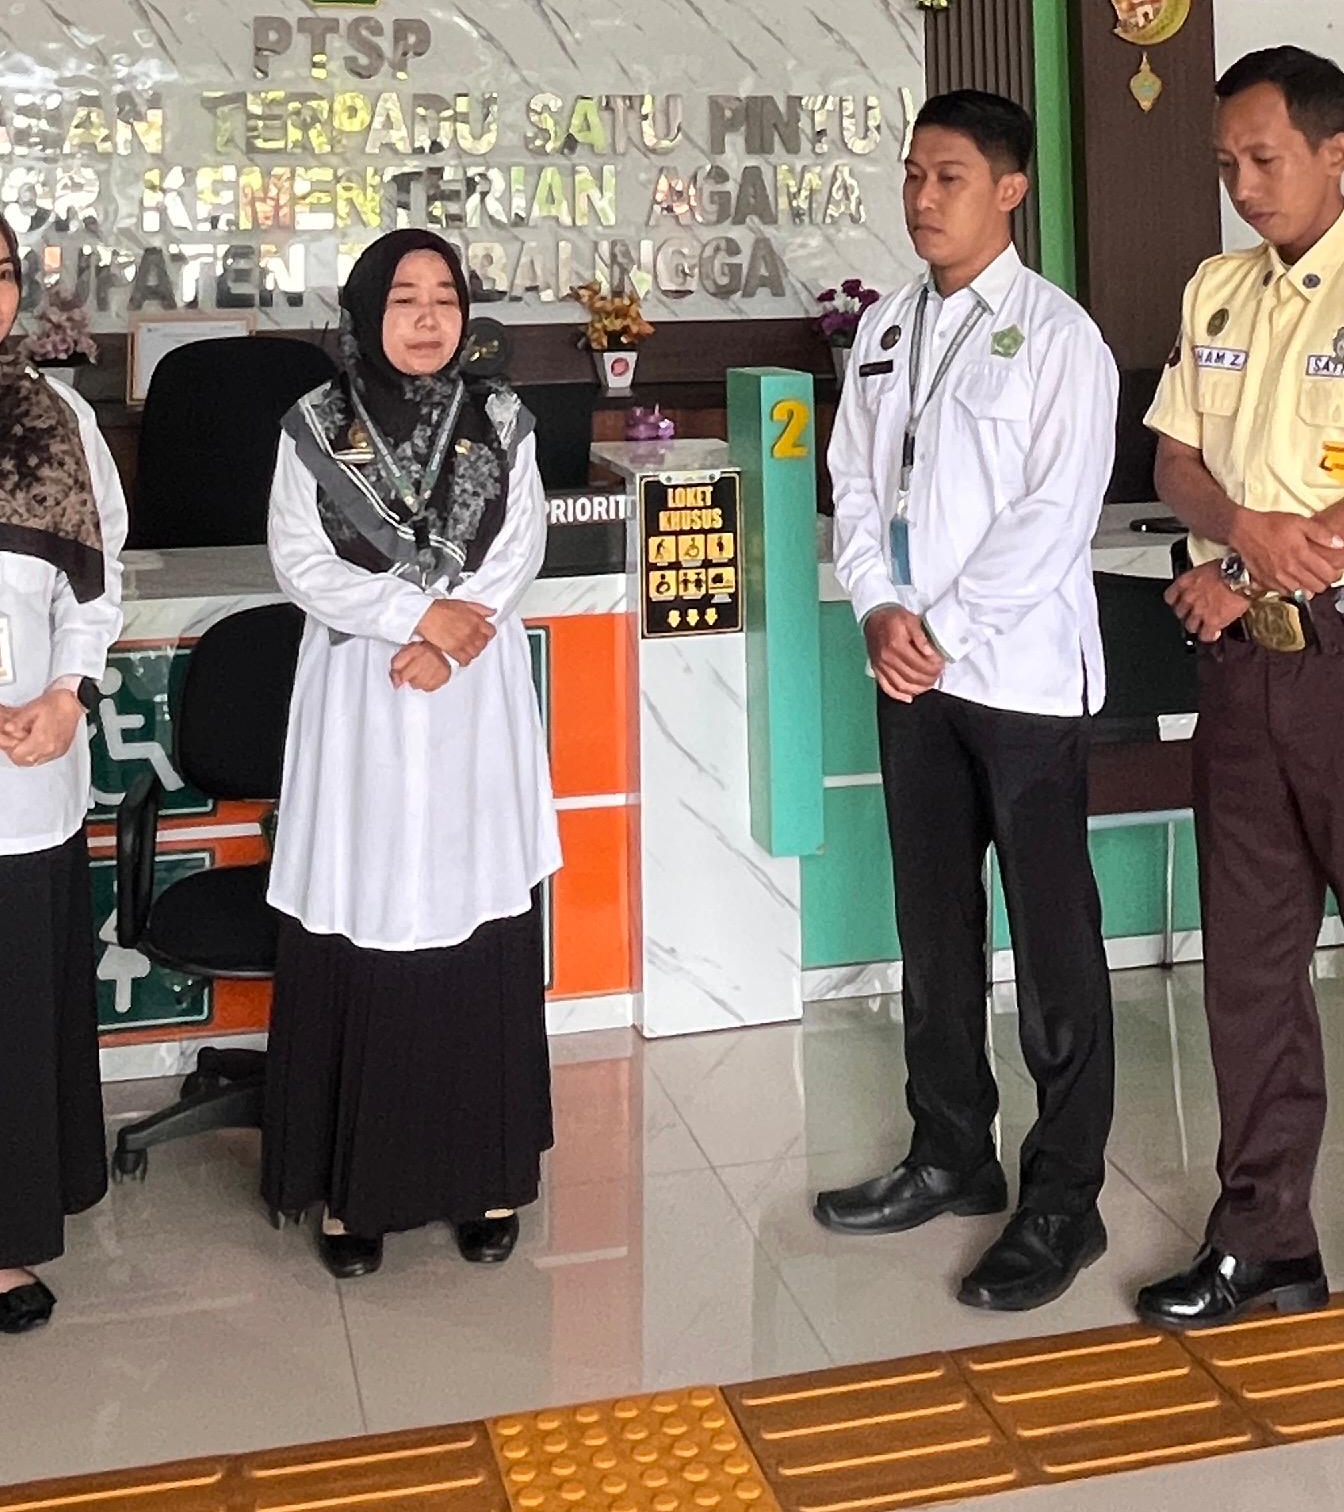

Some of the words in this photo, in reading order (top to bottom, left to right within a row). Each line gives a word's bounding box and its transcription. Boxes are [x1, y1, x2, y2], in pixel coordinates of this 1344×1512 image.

[253, 15, 432, 81] PTSP
[200, 91, 498, 155] TERPADU
[524, 92, 684, 155] SATU
[143, 163, 618, 230] KEMENTERIAN
[654, 163, 866, 228] AGAMA
[770, 398, 808, 460] 2
[659, 507, 723, 532] KHUSUS
[667, 485, 714, 508] LOKET
